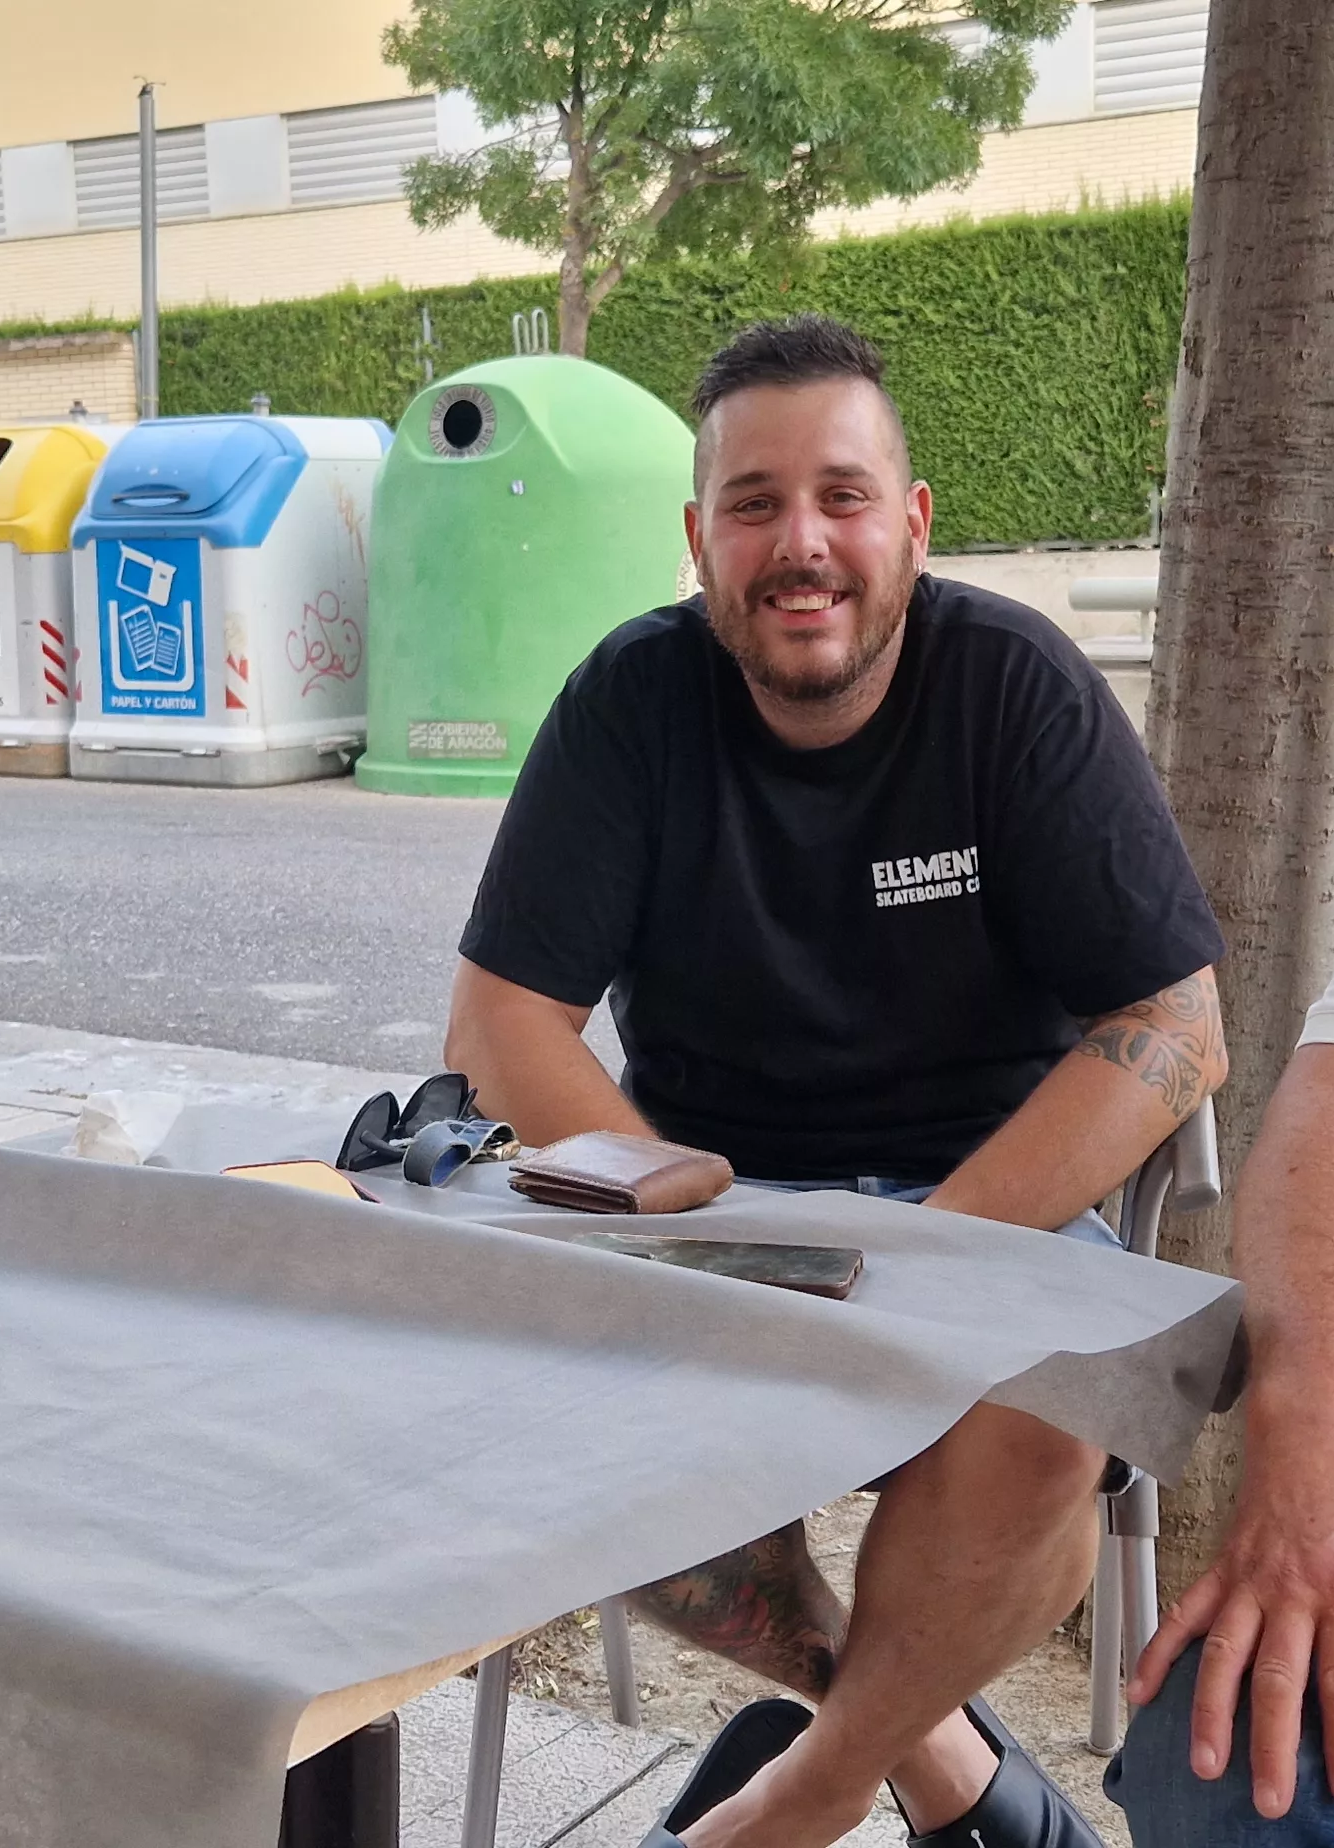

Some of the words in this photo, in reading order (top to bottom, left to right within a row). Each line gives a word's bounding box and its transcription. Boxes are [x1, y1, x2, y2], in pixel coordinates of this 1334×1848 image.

[111, 695, 142, 708] PAPEL
[144, 696, 152, 708] Y
[154, 695, 196, 710] CARTÓN
[429, 722, 496, 735] GOBIERNO
[429, 736, 444, 749] DE
[872, 846, 978, 889] ELEMENT
[876, 881, 962, 907] SKATEBOARD
